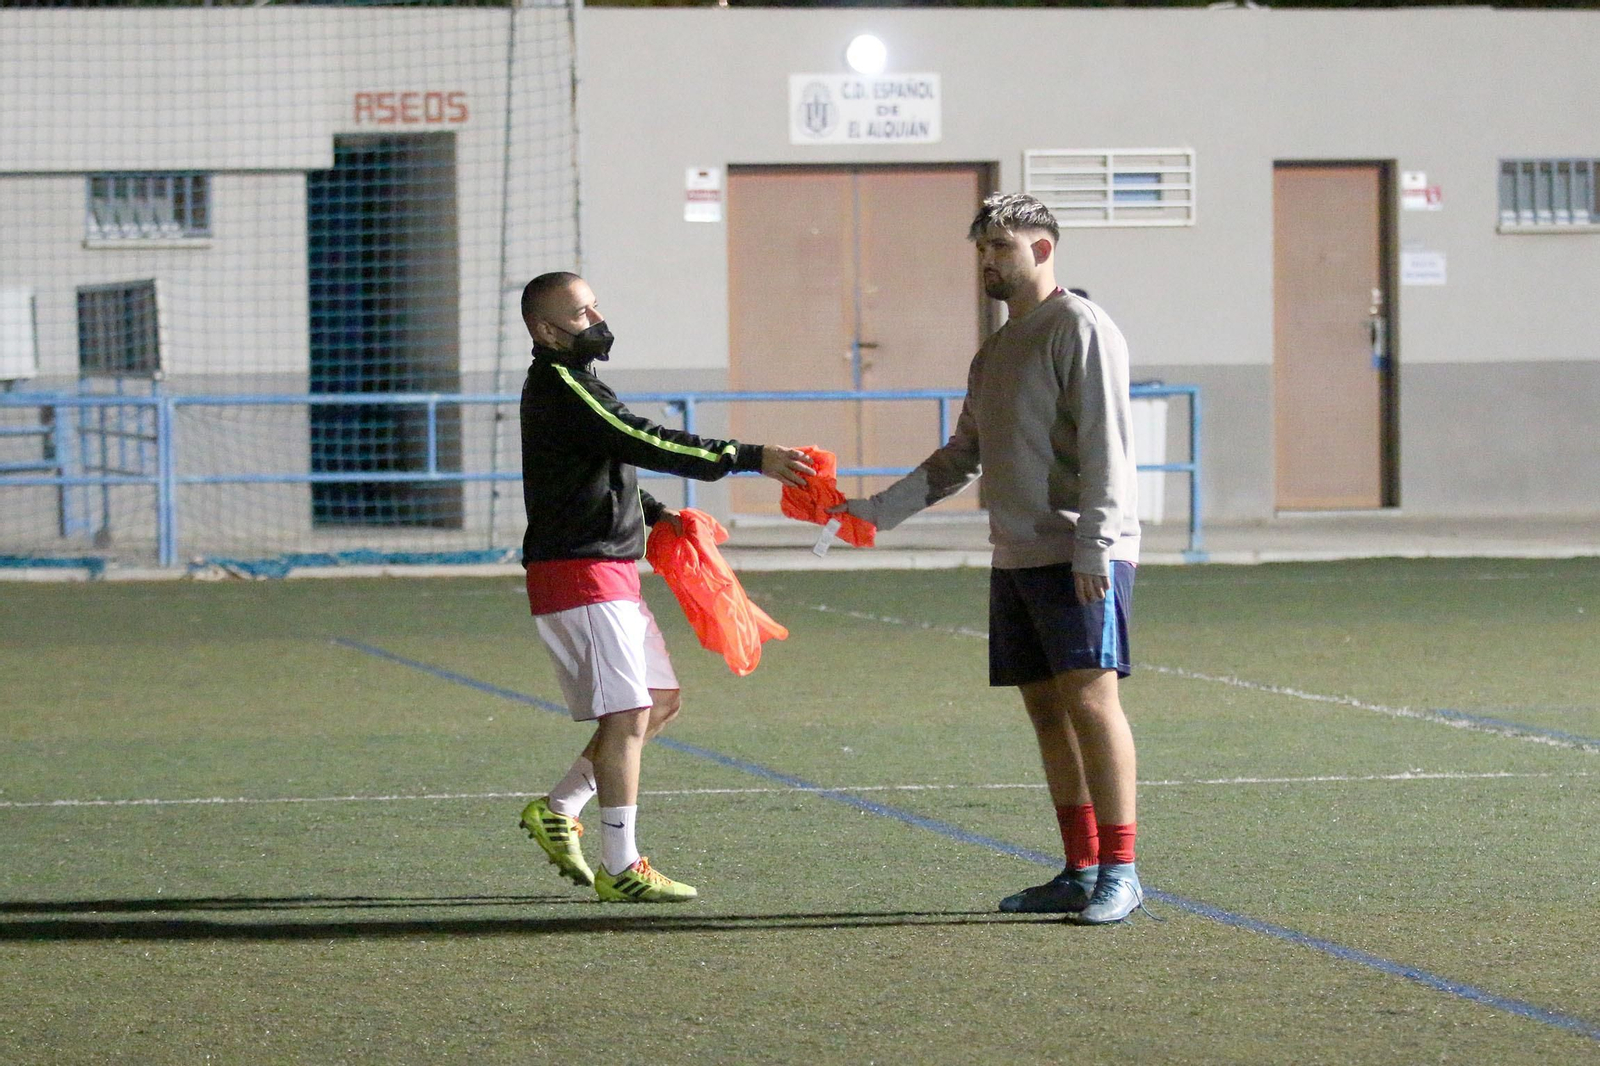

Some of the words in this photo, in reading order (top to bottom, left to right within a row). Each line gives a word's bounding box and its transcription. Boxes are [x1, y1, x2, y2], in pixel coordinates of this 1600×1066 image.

[874, 78, 934, 99] ESPAÑOL
[355, 91, 468, 125] ASEOS
[876, 105, 899, 116] DE
[848, 120, 860, 138] EL
